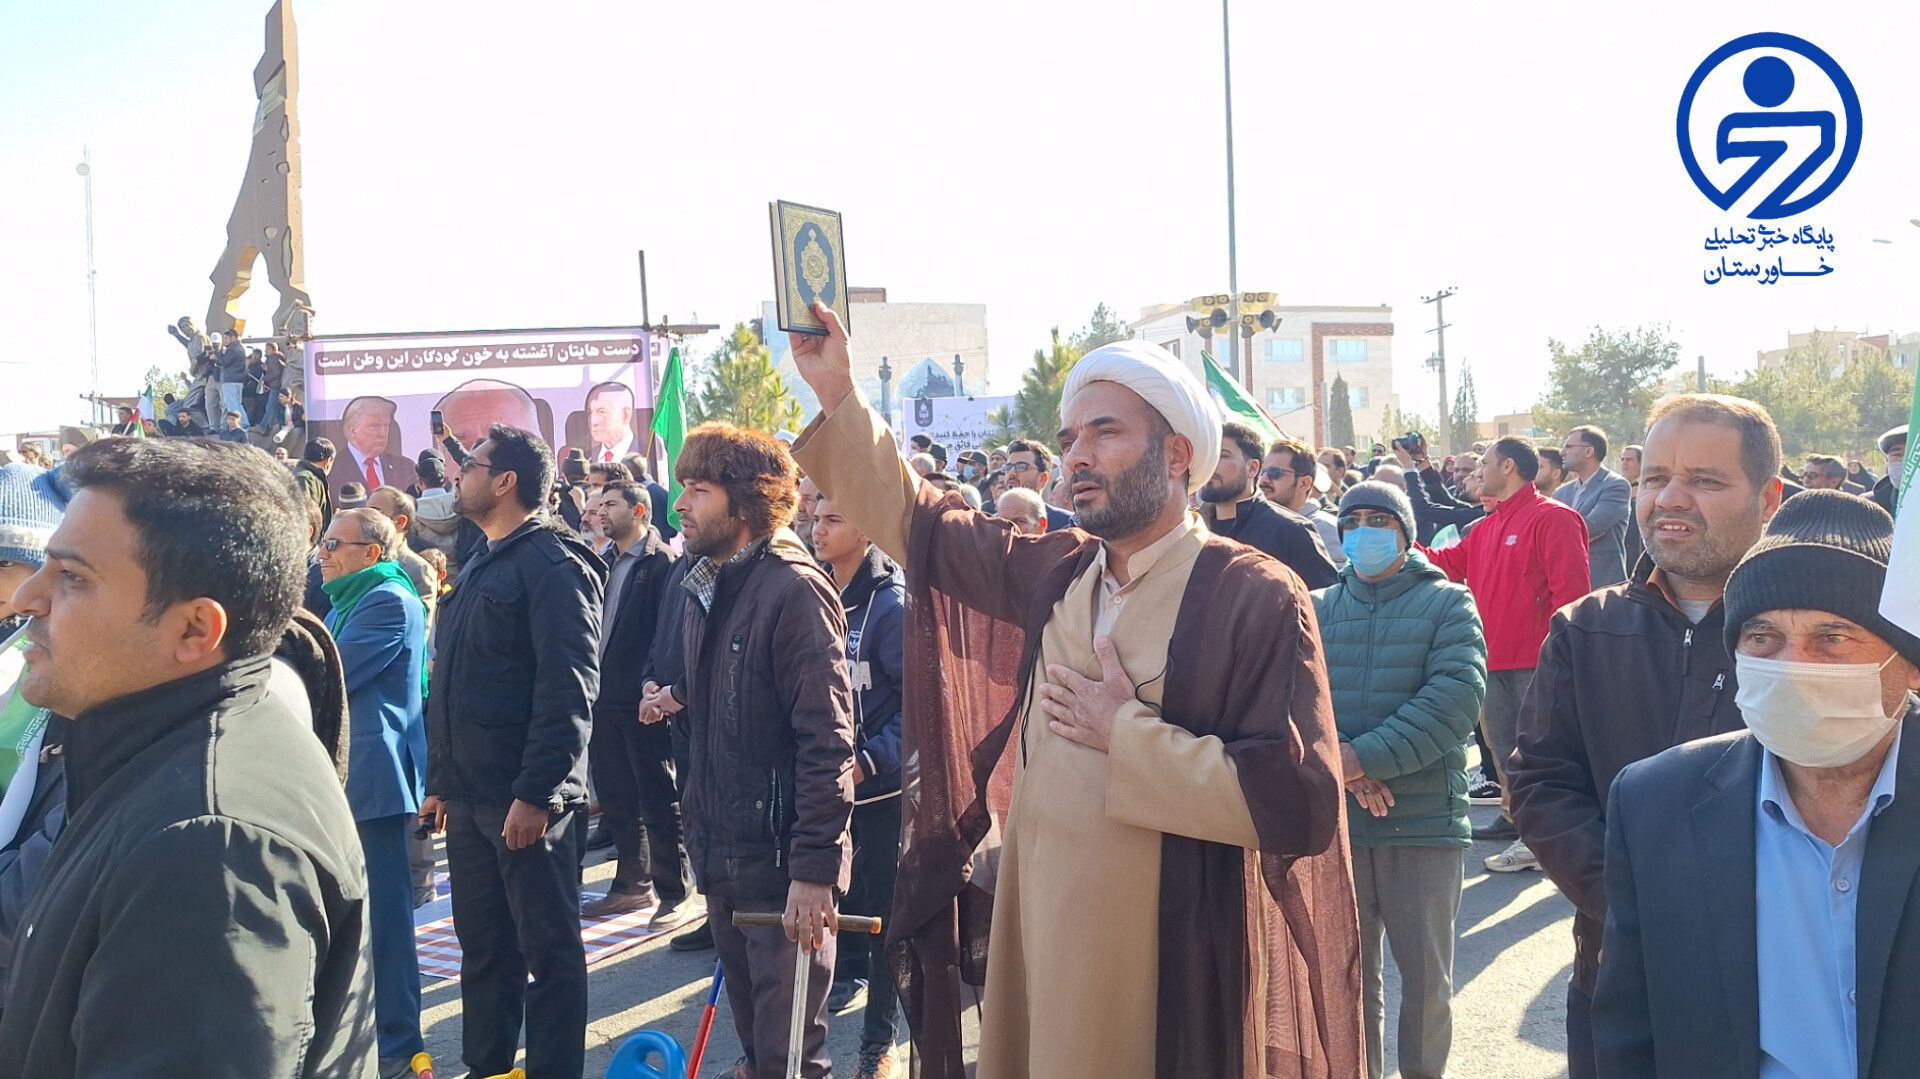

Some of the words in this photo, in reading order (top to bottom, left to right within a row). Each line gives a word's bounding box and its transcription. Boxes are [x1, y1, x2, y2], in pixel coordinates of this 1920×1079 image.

[411, 349, 461, 369] کودکان
[461, 346, 493, 367] خون
[495, 347, 509, 364] به
[512, 343, 555, 361] آغشته
[557, 342, 600, 363] هایتان
[602, 342, 640, 357] دست
[317, 353, 351, 369] است
[352, 352, 384, 372] وطن
[386, 350, 409, 370] این
